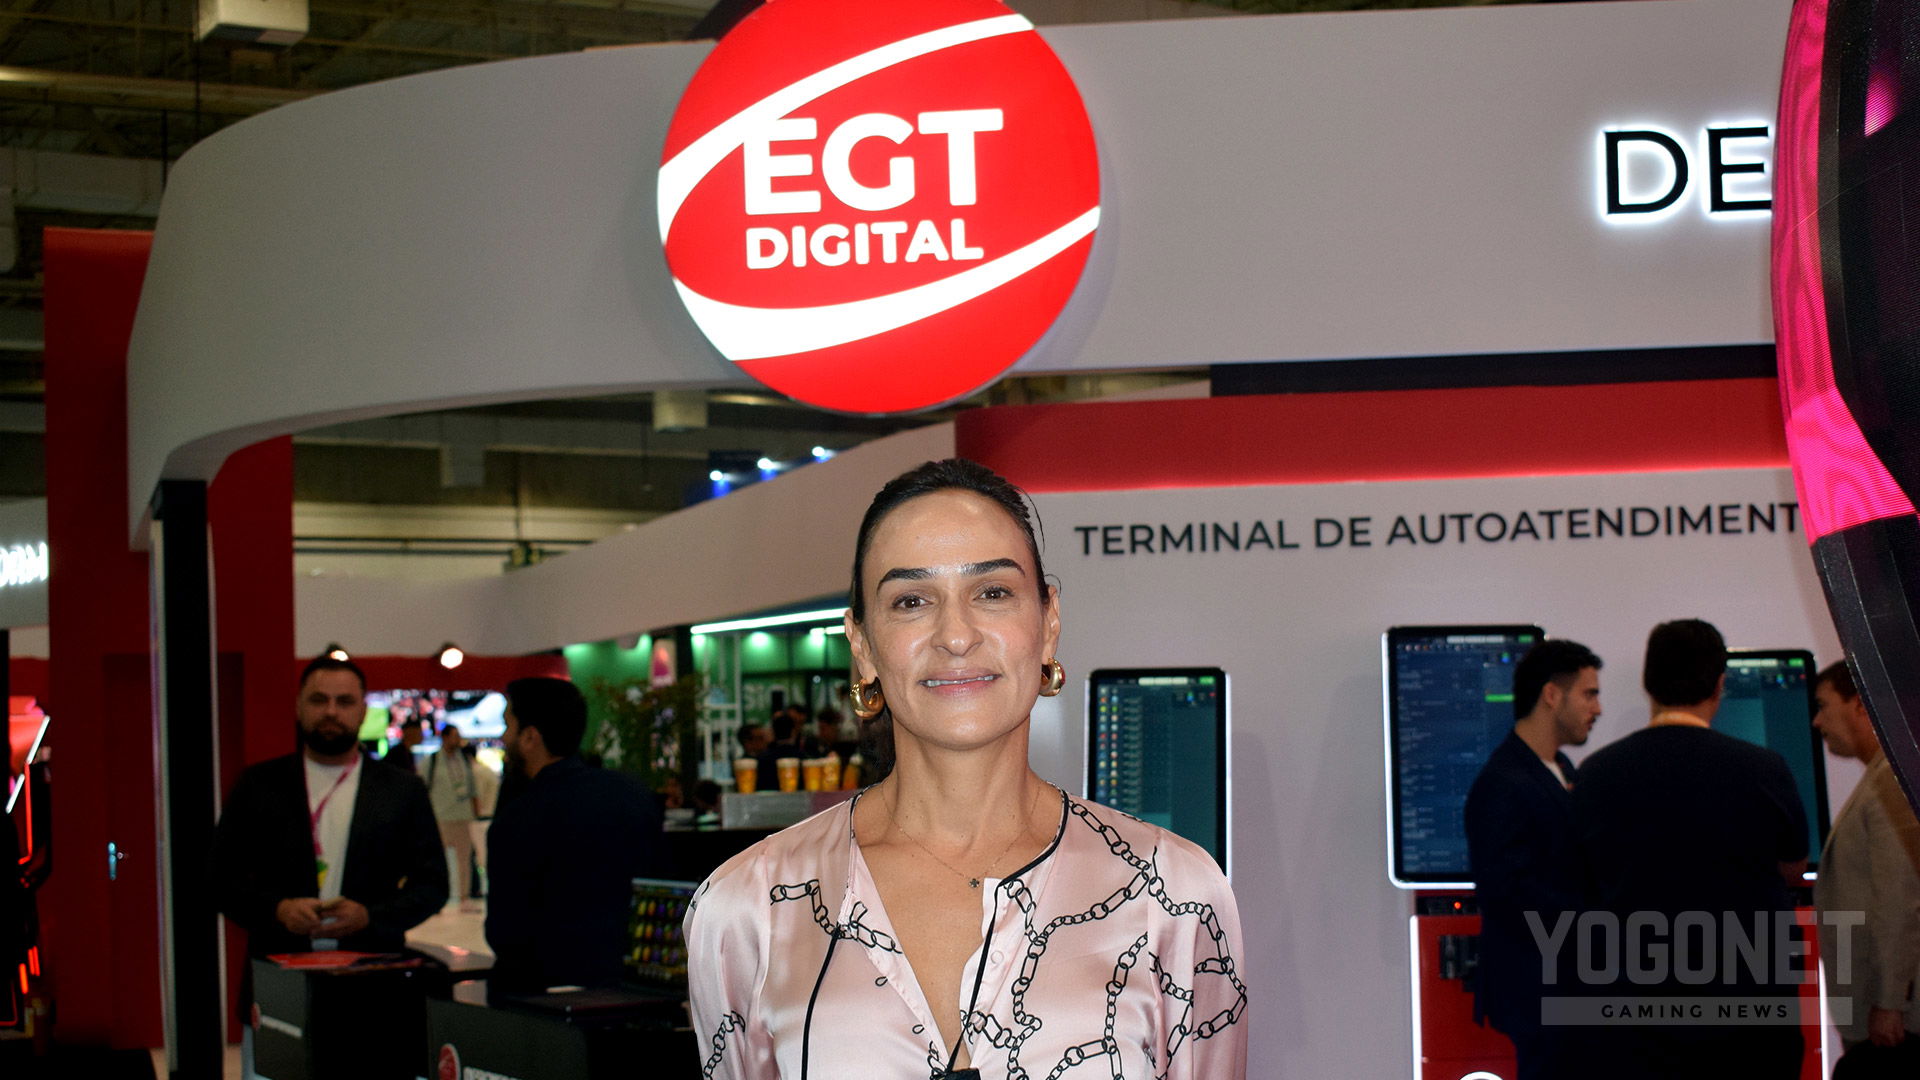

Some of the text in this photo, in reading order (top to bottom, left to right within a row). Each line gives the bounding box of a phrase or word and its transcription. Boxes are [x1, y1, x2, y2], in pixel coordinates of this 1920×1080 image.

[743, 108, 1004, 216] EGT
[1604, 126, 1773, 215] DE
[745, 218, 985, 270] DIGITAL
[1074, 502, 1800, 556] TERMINAL DE AUTOATENDIMENT
